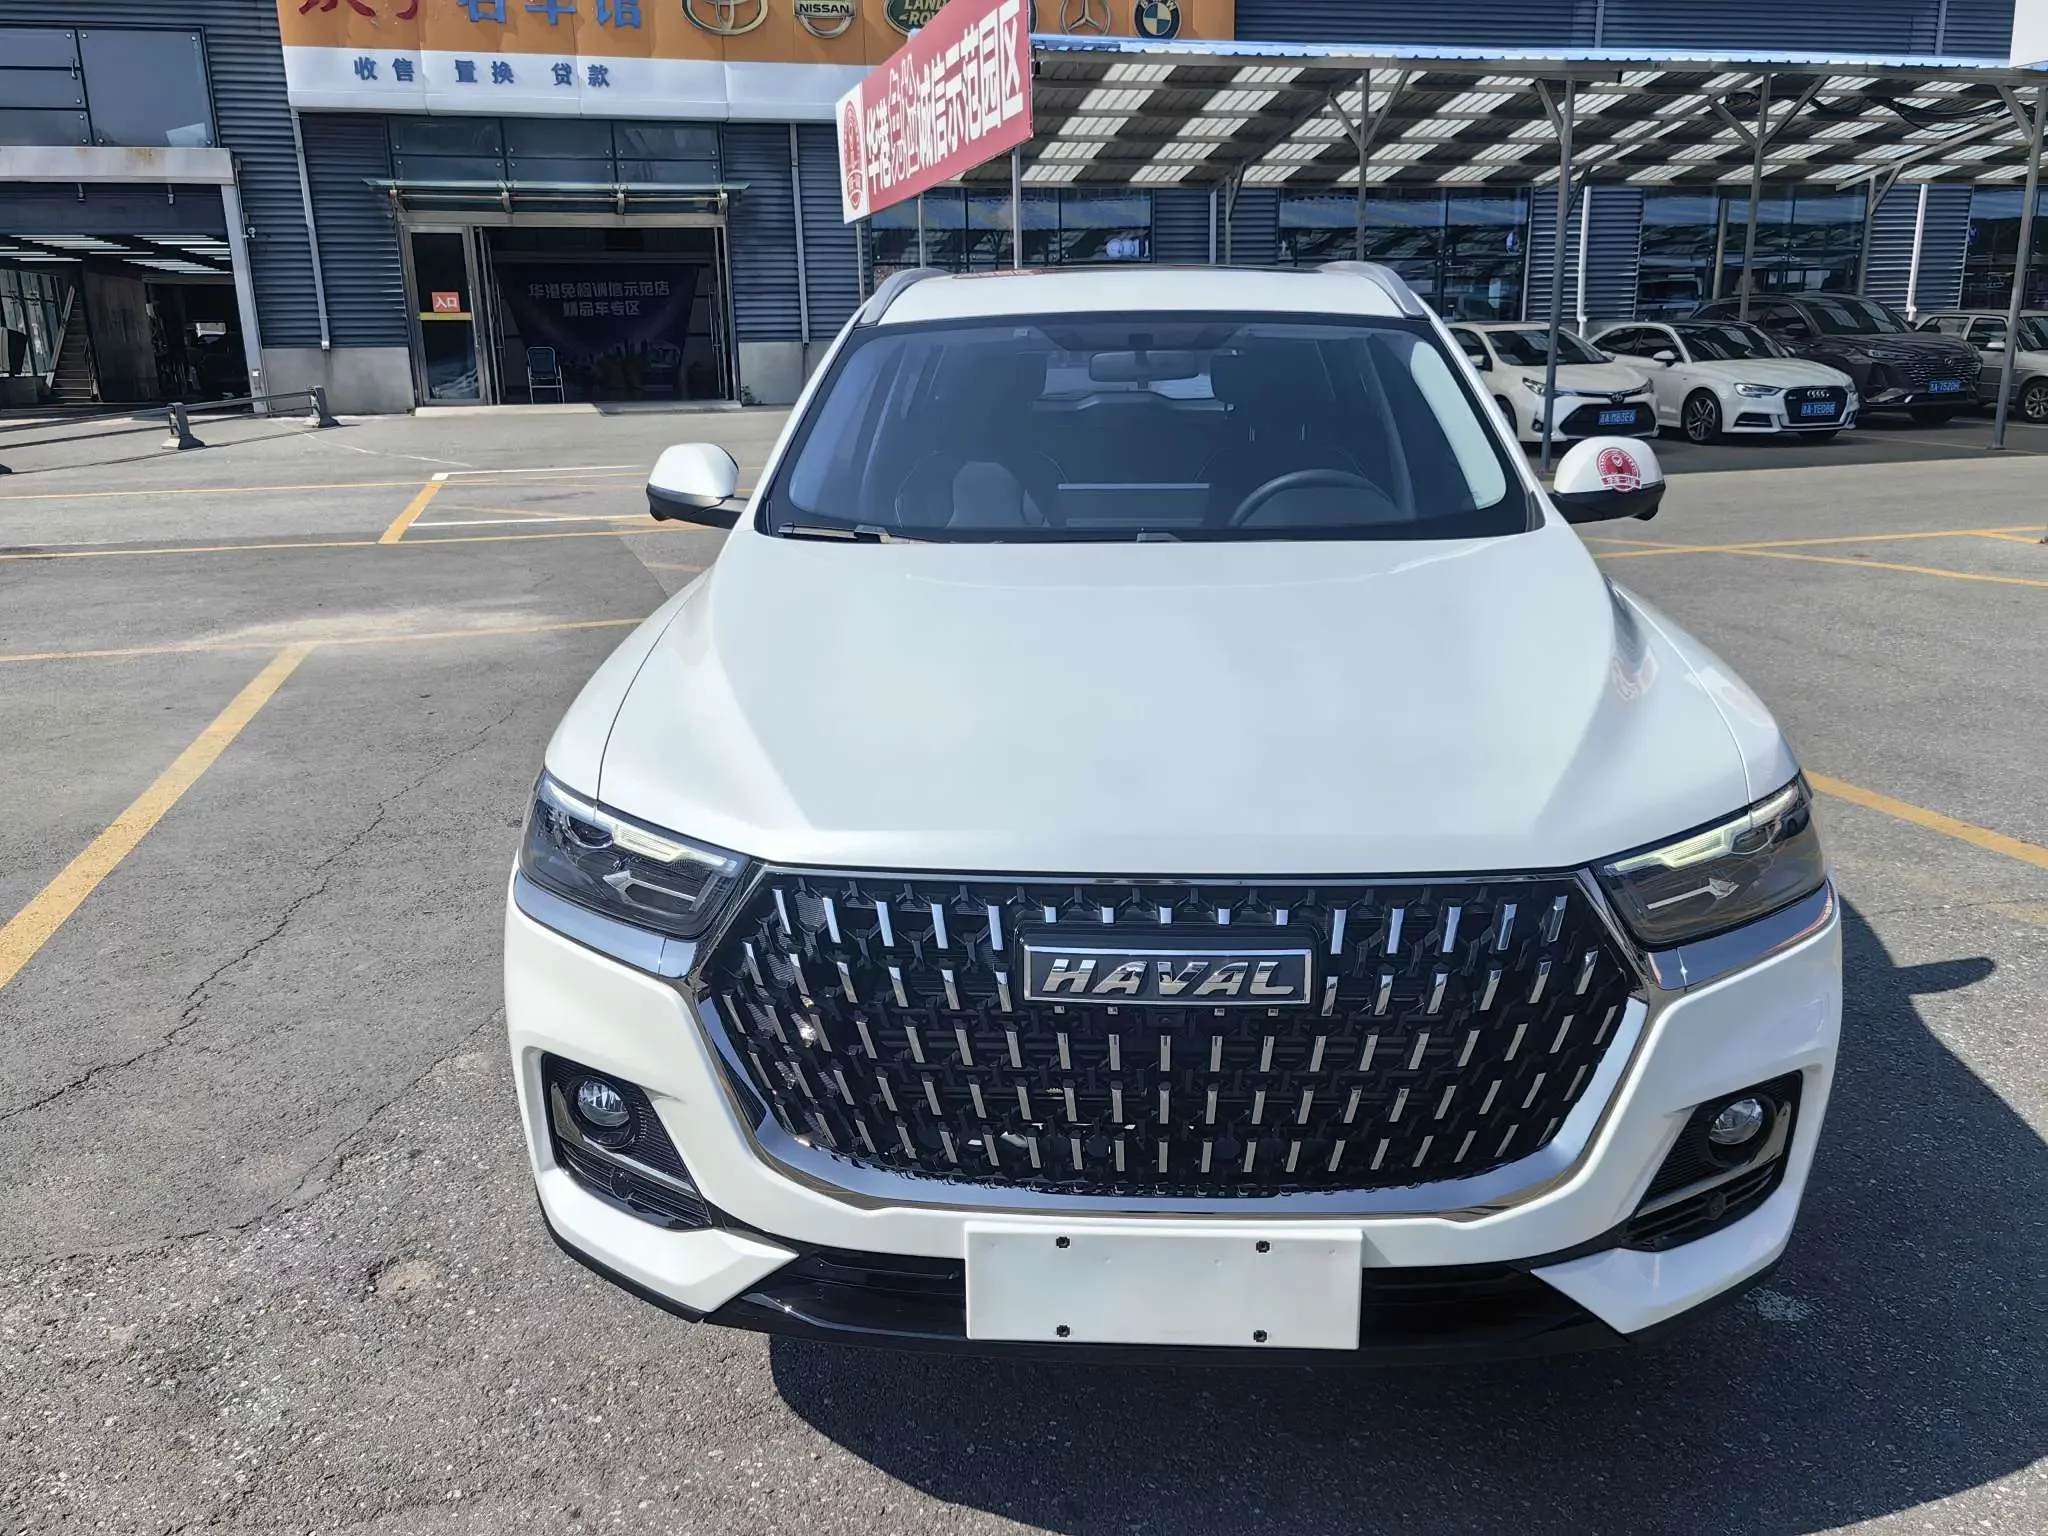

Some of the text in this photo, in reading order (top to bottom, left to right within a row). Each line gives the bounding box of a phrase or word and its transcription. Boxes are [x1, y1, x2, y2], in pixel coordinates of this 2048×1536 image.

[799, 3, 850, 14] NISSAN
[353, 56, 610, 88] 收售 置换 贷款
[866, 0, 1023, 195] 华港免检诚信示范园区
[435, 296, 457, 308] 入口
[1042, 958, 1295, 996] HAVAL
